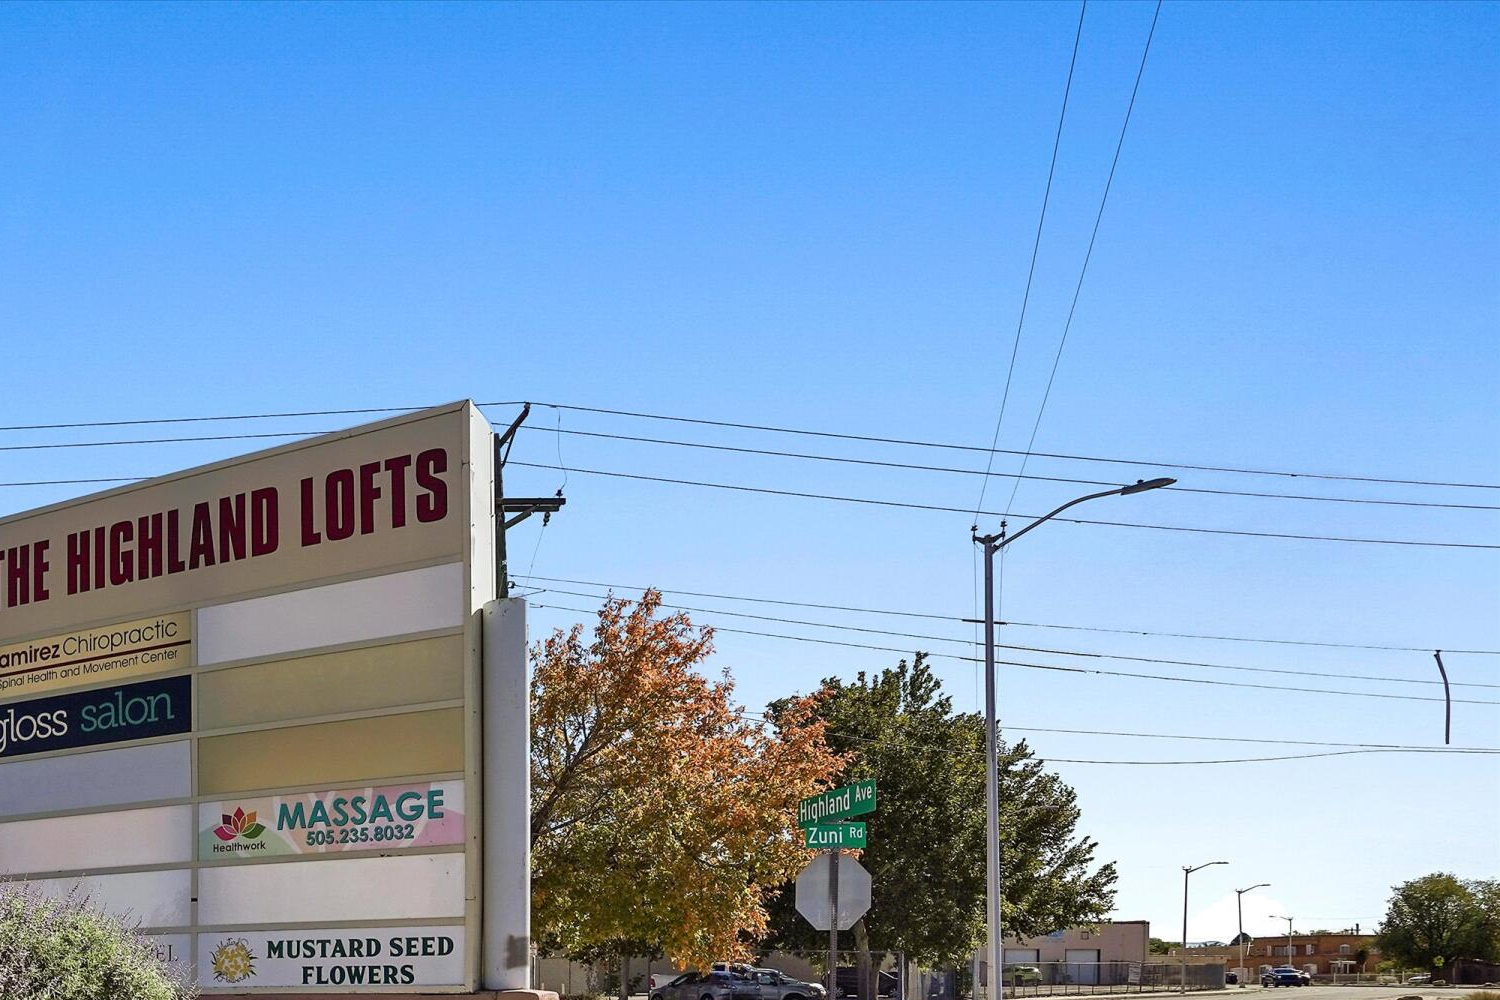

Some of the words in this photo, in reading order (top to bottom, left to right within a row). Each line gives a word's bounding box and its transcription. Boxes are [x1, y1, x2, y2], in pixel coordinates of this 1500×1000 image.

[67, 486, 279, 596] HIGHLAND
[300, 447, 448, 547] LOFTS
[62, 619, 178, 656] Chiropractic
[27, 670, 58, 684] Health
[61, 665, 81, 679] and
[83, 655, 139, 675] Movement
[140, 648, 178, 664] Center
[80, 691, 175, 733] salon
[276, 789, 445, 831] MASSAGE
[800, 788, 850, 823] Highland
[855, 785, 872, 803] Ave
[212, 840, 267, 853] Healthwork
[306, 824, 415, 846] 505.235.8032
[808, 827, 843, 844] Zuni
[850, 827, 862, 838] Rd
[266, 938, 382, 959] MUSTARD
[389, 936, 455, 957] SEED
[301, 964, 415, 985] FLOWERS
